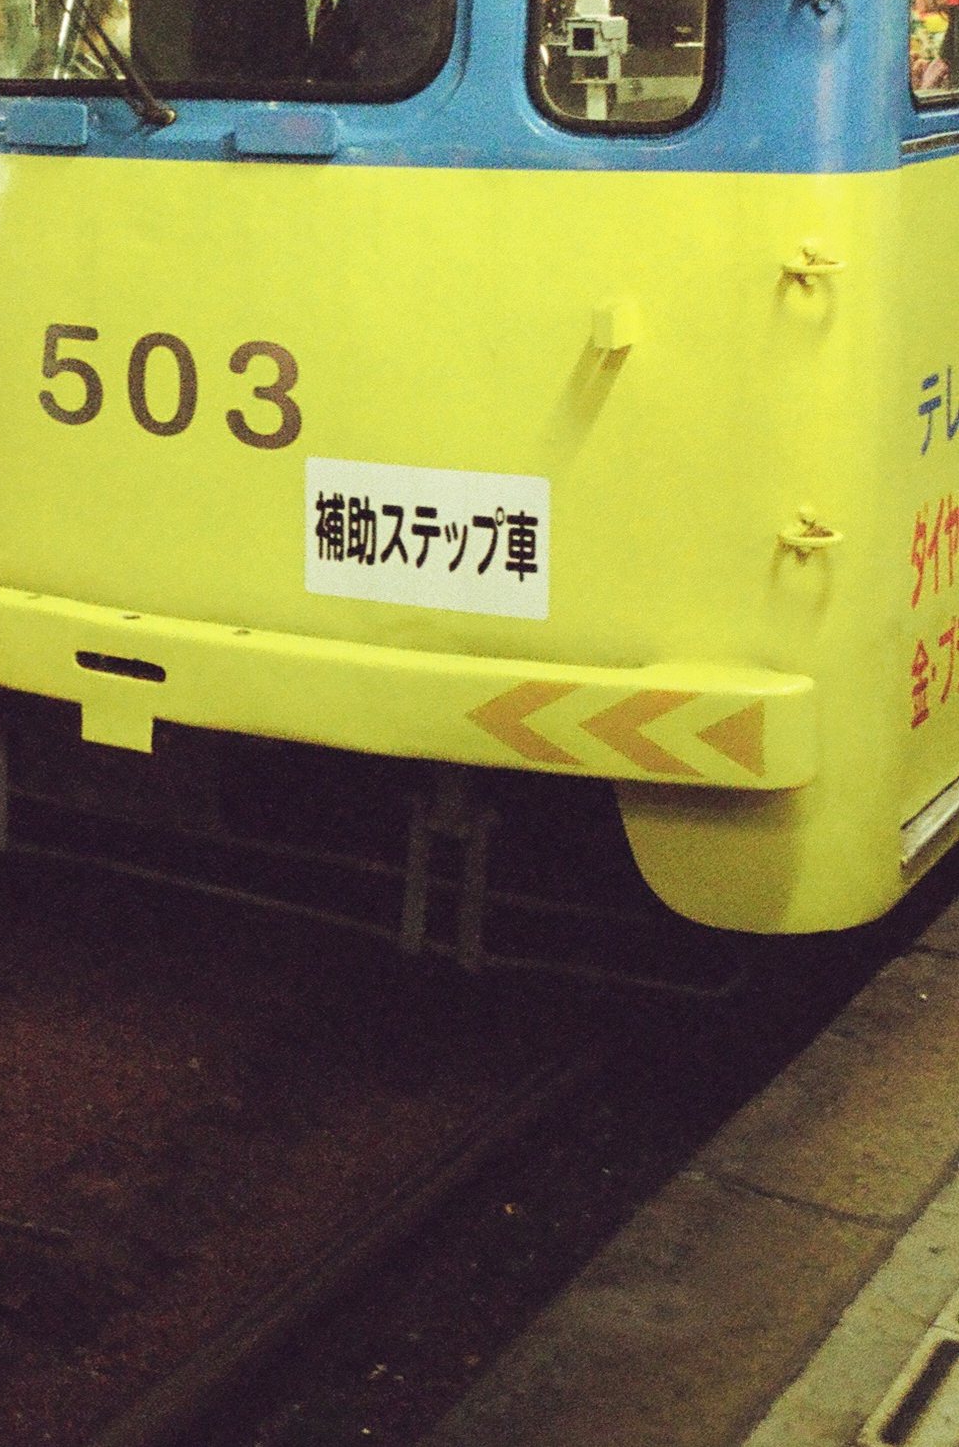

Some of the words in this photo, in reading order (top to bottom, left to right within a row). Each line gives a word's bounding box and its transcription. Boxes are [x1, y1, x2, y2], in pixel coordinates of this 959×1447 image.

[39, 323, 303, 451] 503
[315, 491, 539, 582] 補助ステップ車
